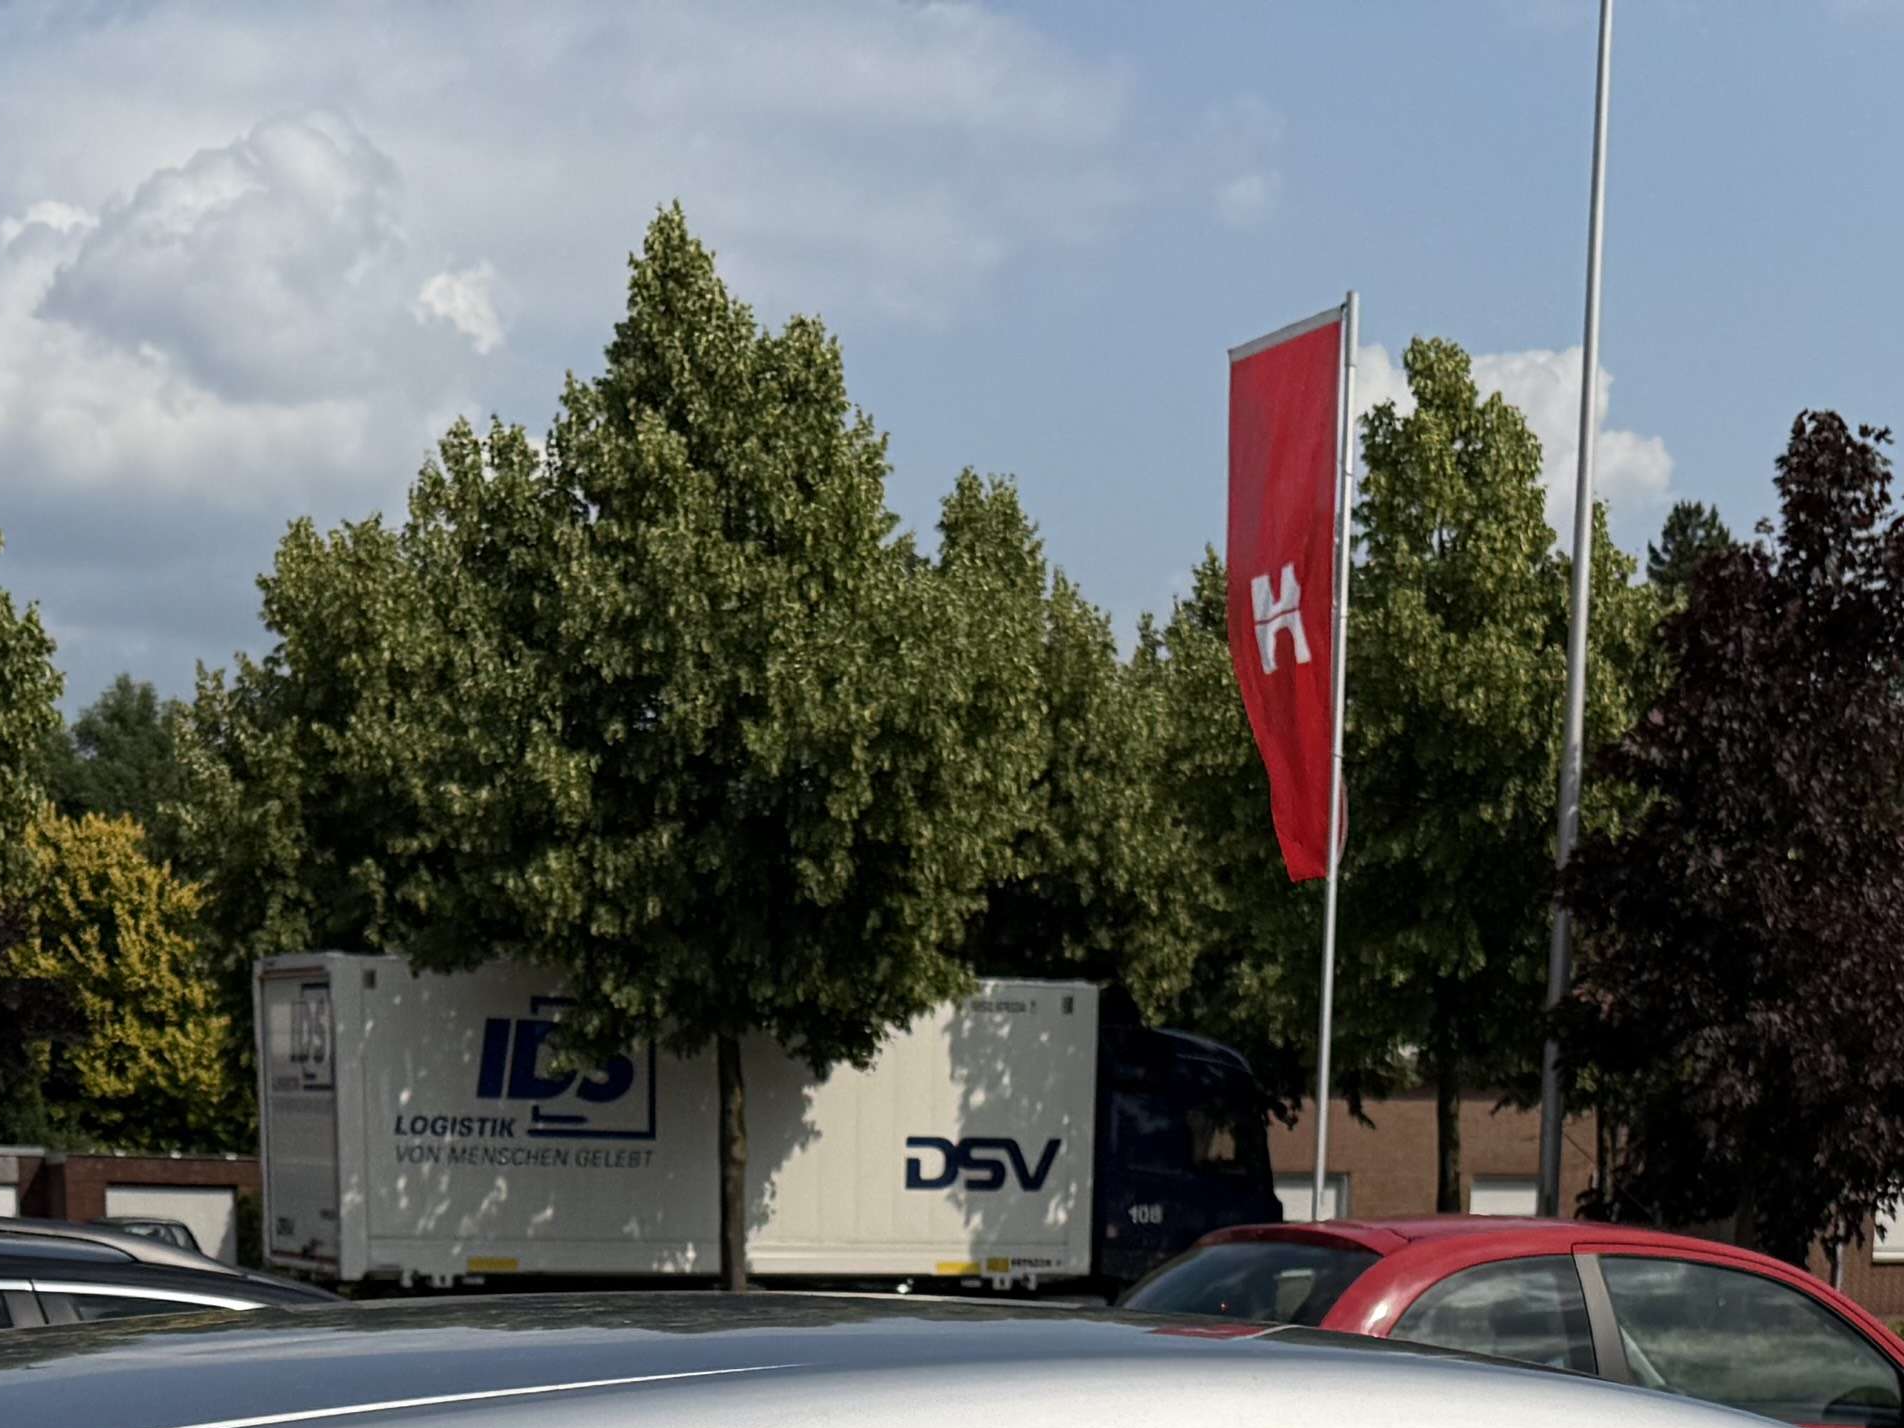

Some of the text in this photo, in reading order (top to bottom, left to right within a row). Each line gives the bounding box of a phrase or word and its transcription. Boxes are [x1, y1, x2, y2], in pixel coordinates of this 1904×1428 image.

[395, 1115, 516, 1138] LOGISTIK
[395, 1145, 653, 1168] VON MENSCHEN GELEBT
[904, 1136, 1062, 1192] DSV
